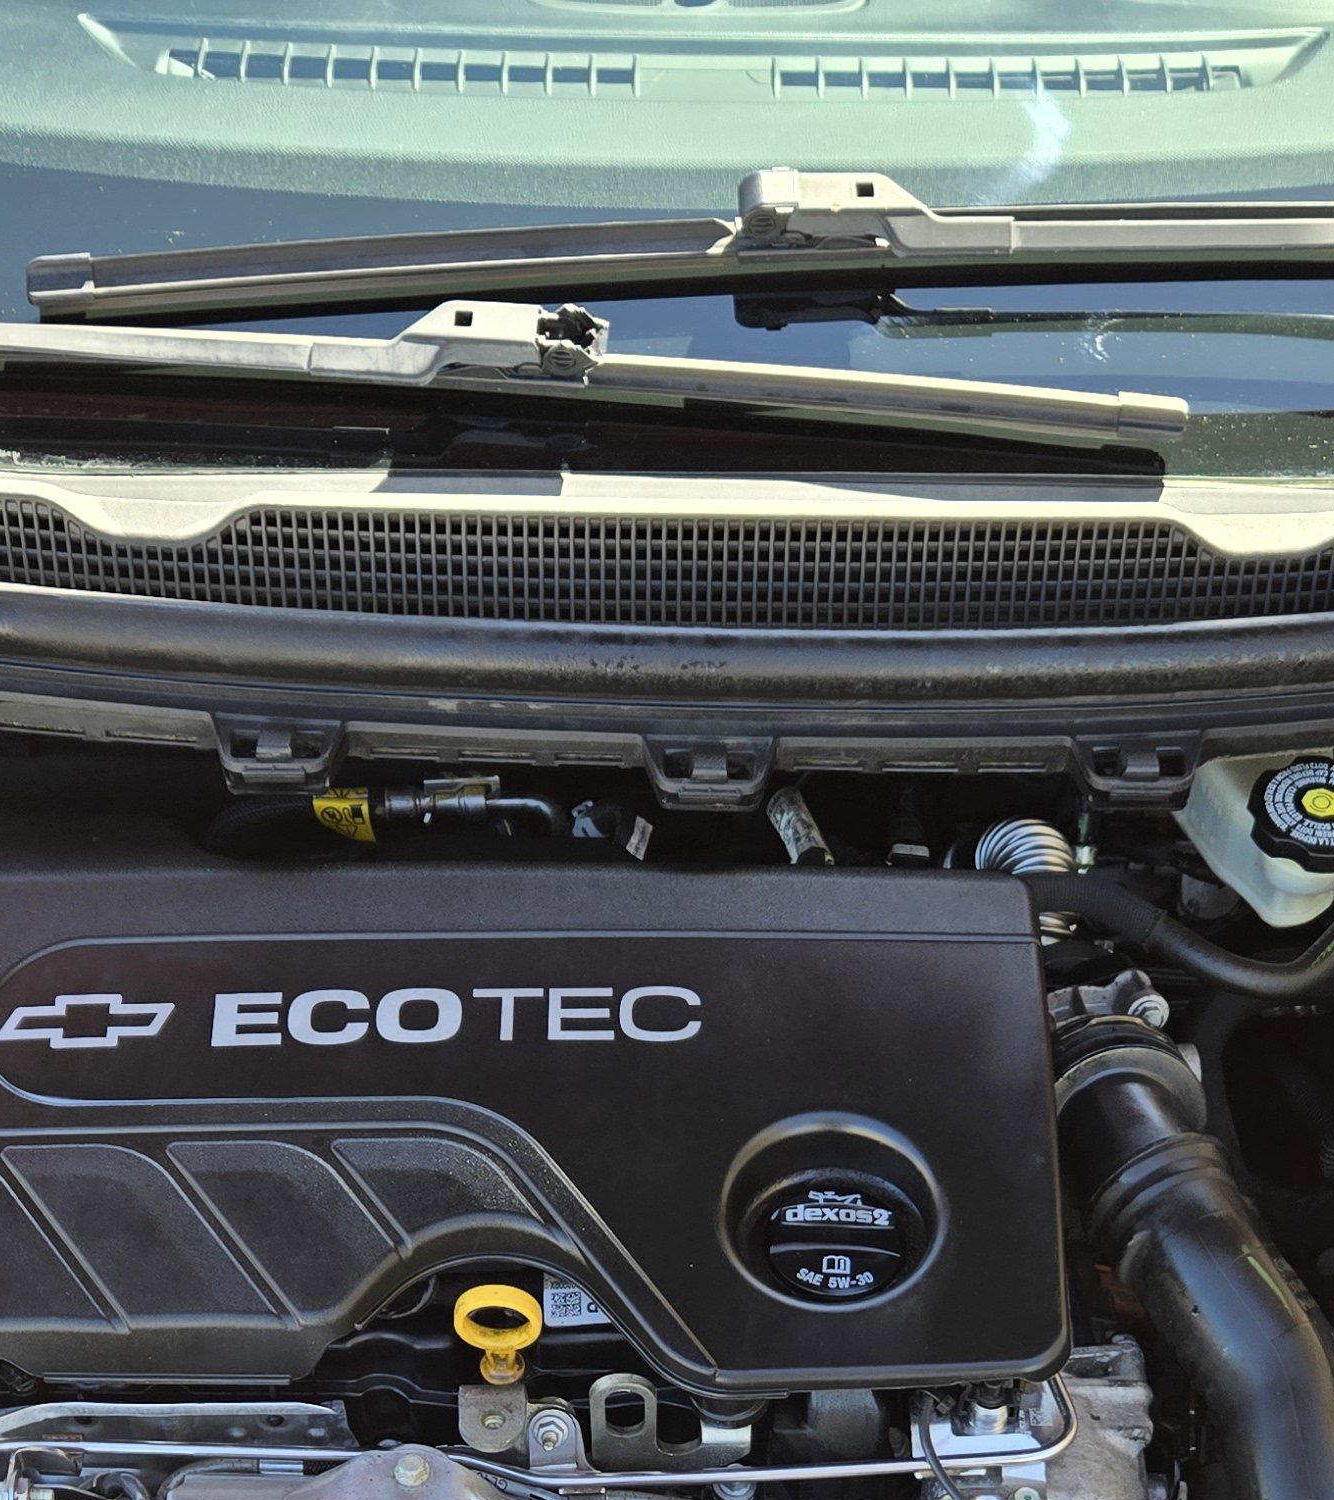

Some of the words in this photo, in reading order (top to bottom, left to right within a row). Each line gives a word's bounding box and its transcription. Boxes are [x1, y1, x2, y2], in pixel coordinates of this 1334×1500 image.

[210, 985, 703, 1047] ECOTEC
[785, 1203, 892, 1227] dexos2
[796, 1267, 824, 1287] SAE
[827, 1271, 874, 1289] 5W-30
